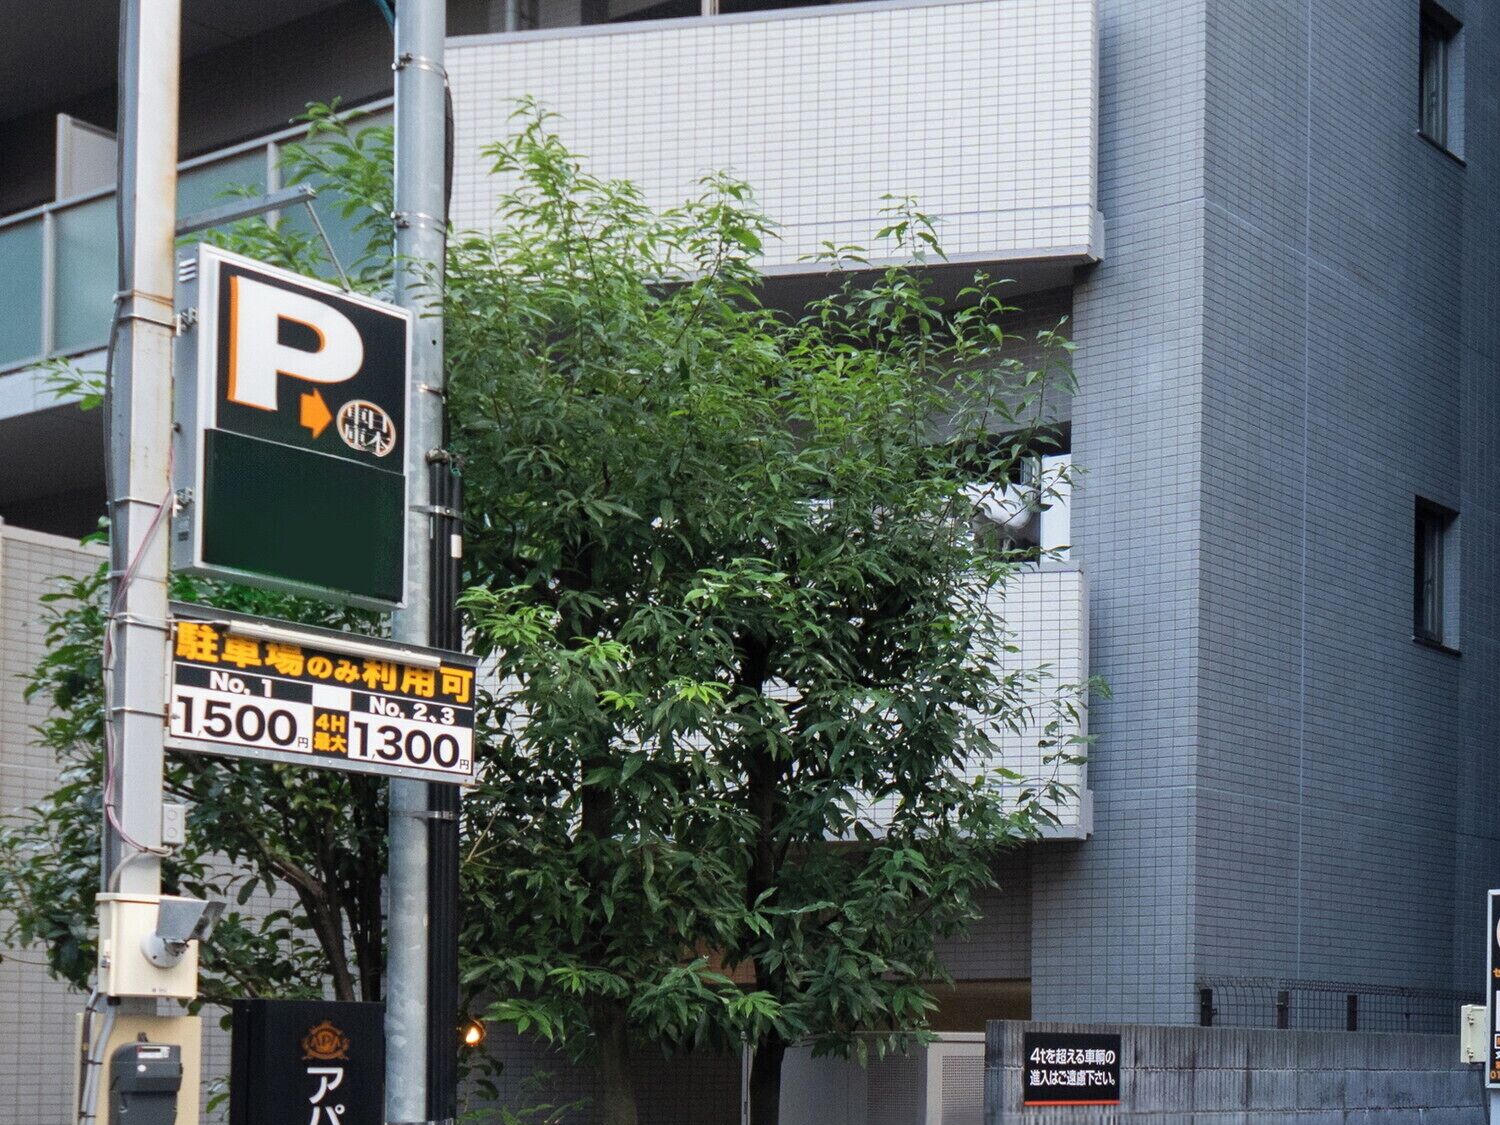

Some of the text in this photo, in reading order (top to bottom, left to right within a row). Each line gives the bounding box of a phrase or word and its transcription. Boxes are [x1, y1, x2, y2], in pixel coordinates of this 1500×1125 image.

[228, 275, 364, 411] P
[176, 621, 474, 704] 駐車場のみ利用可
[314, 735, 347, 752] 最大
[315, 713, 345, 732] 4H
